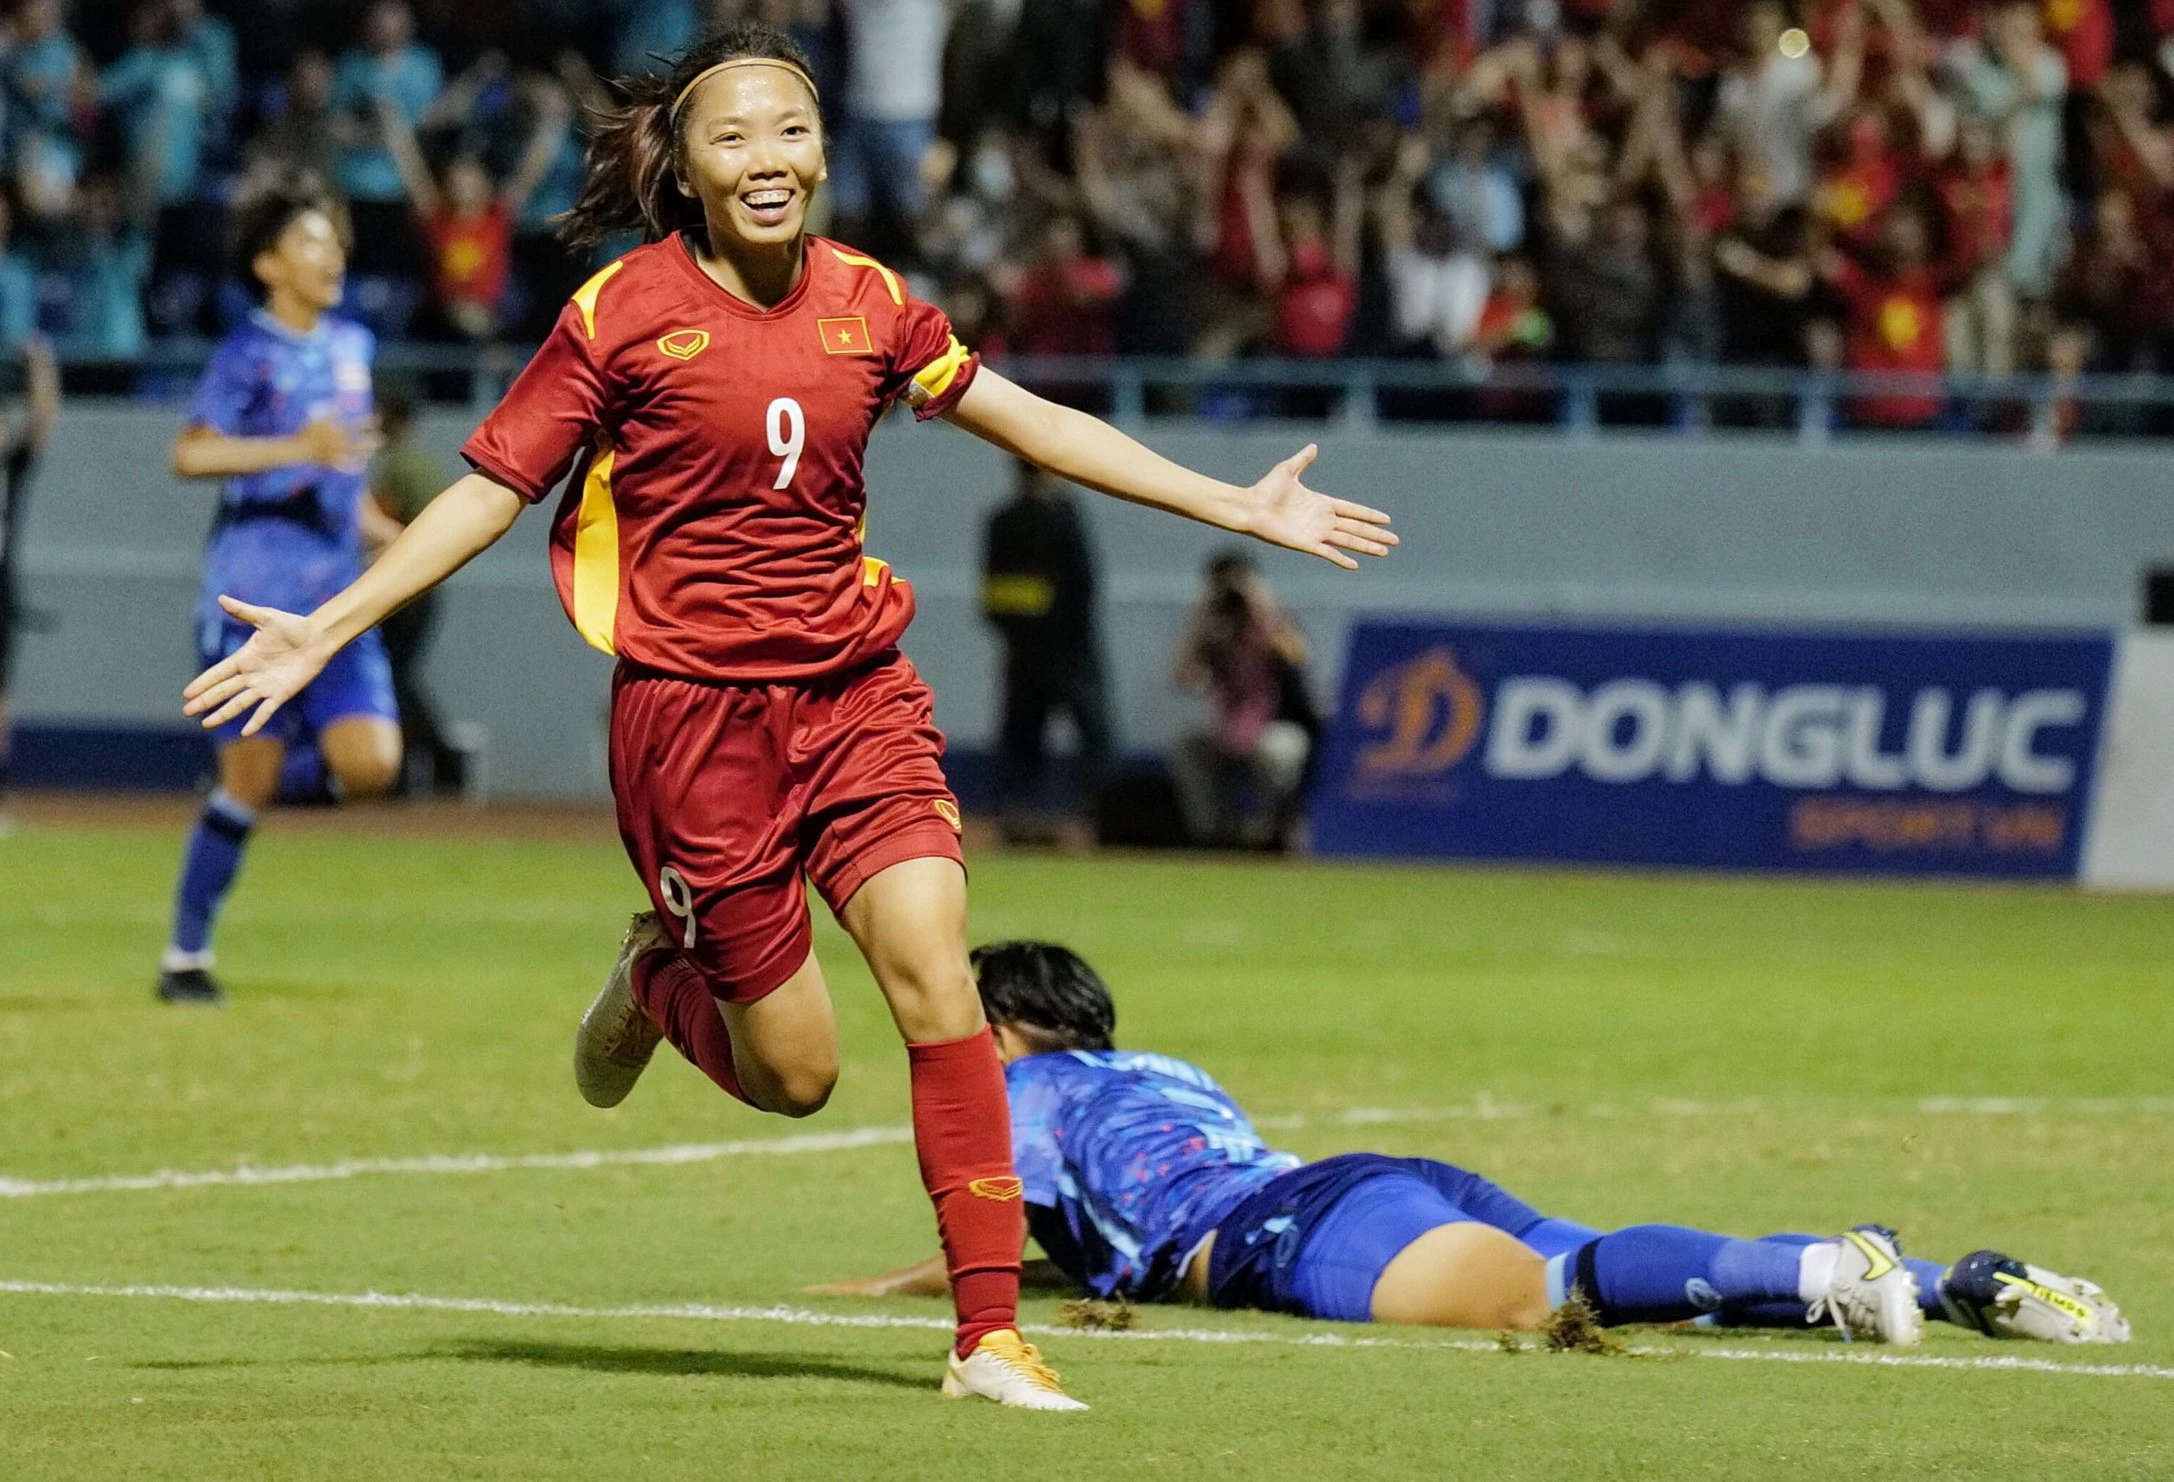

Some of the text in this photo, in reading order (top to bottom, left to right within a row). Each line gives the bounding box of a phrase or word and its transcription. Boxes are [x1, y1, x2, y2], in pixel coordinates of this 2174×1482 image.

[765, 396, 806, 490] 9
[1487, 677, 2086, 793] DONGLUC
[660, 866, 695, 949] 9
